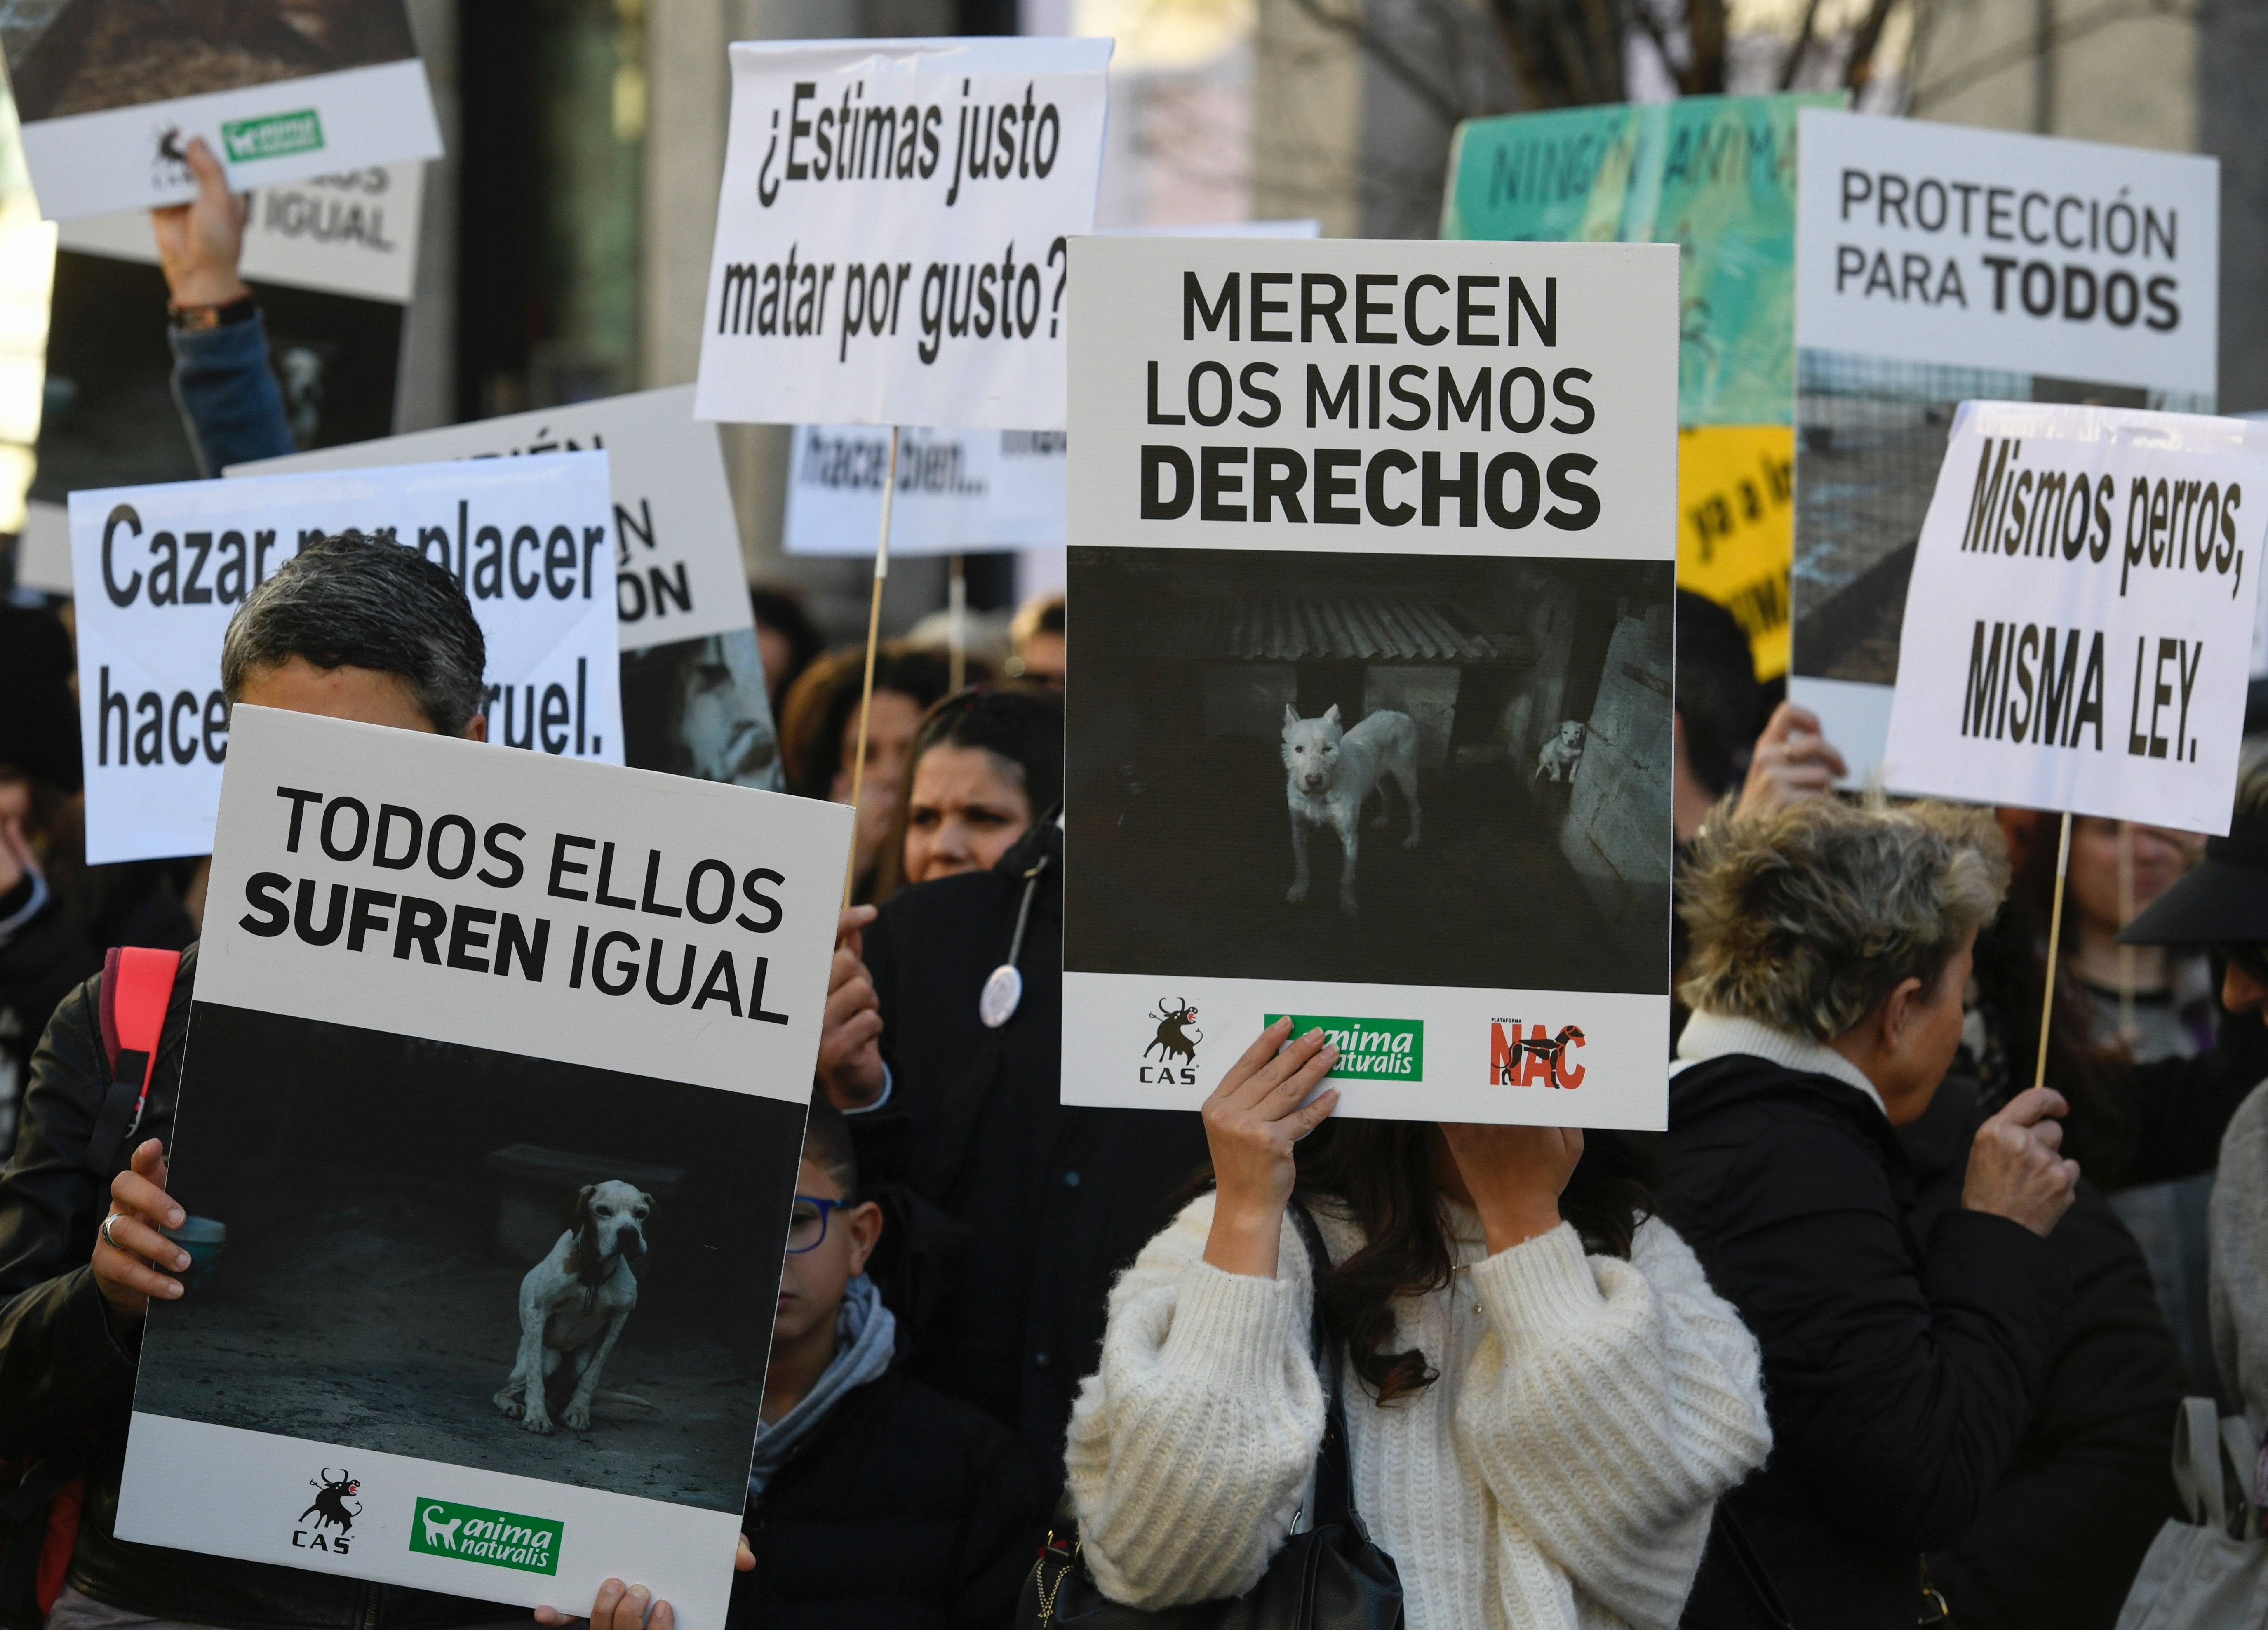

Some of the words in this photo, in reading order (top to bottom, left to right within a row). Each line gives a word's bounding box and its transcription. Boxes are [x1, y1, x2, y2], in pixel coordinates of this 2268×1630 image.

[757, 80, 943, 207] ¿Estimas
[946, 78, 1060, 207] justo
[266, 181, 398, 254] IGUAL
[1840, 169, 2177, 261] PROTECCIÓN
[718, 239, 834, 337] matar
[839, 261, 912, 363] por
[918, 235, 1067, 366] gusto?
[1183, 270, 1557, 348] MERECEN
[1836, 245, 1967, 307] PARA
[1981, 254, 2181, 334] TODOS
[1147, 360, 1281, 428] LOS
[1305, 363, 1596, 435] MISMOS
[1140, 444, 1601, 532] DERECHOS
[1960, 437, 2115, 565] Mismos
[2118, 475, 2244, 600] perros,
[101, 504, 277, 608] Cazar
[98, 665, 230, 767] hace
[480, 657, 602, 755] ruel.
[1961, 619, 2105, 752] MISMA
[2127, 636, 2204, 764] LEY.
[276, 786, 527, 889] TODOS
[547, 833, 786, 934] ELLOS
[238, 871, 551, 983] SUFREN
[569, 924, 789, 1026] IGUAL
[1140, 1066, 1196, 1085] CAS
[1333, 1051, 1413, 1074] aturalis
[1490, 1022, 1586, 1089] NAC
[291, 1529, 350, 1555] CAS
[460, 1538, 550, 1567] naturalis
[463, 1517, 553, 1549] anima
